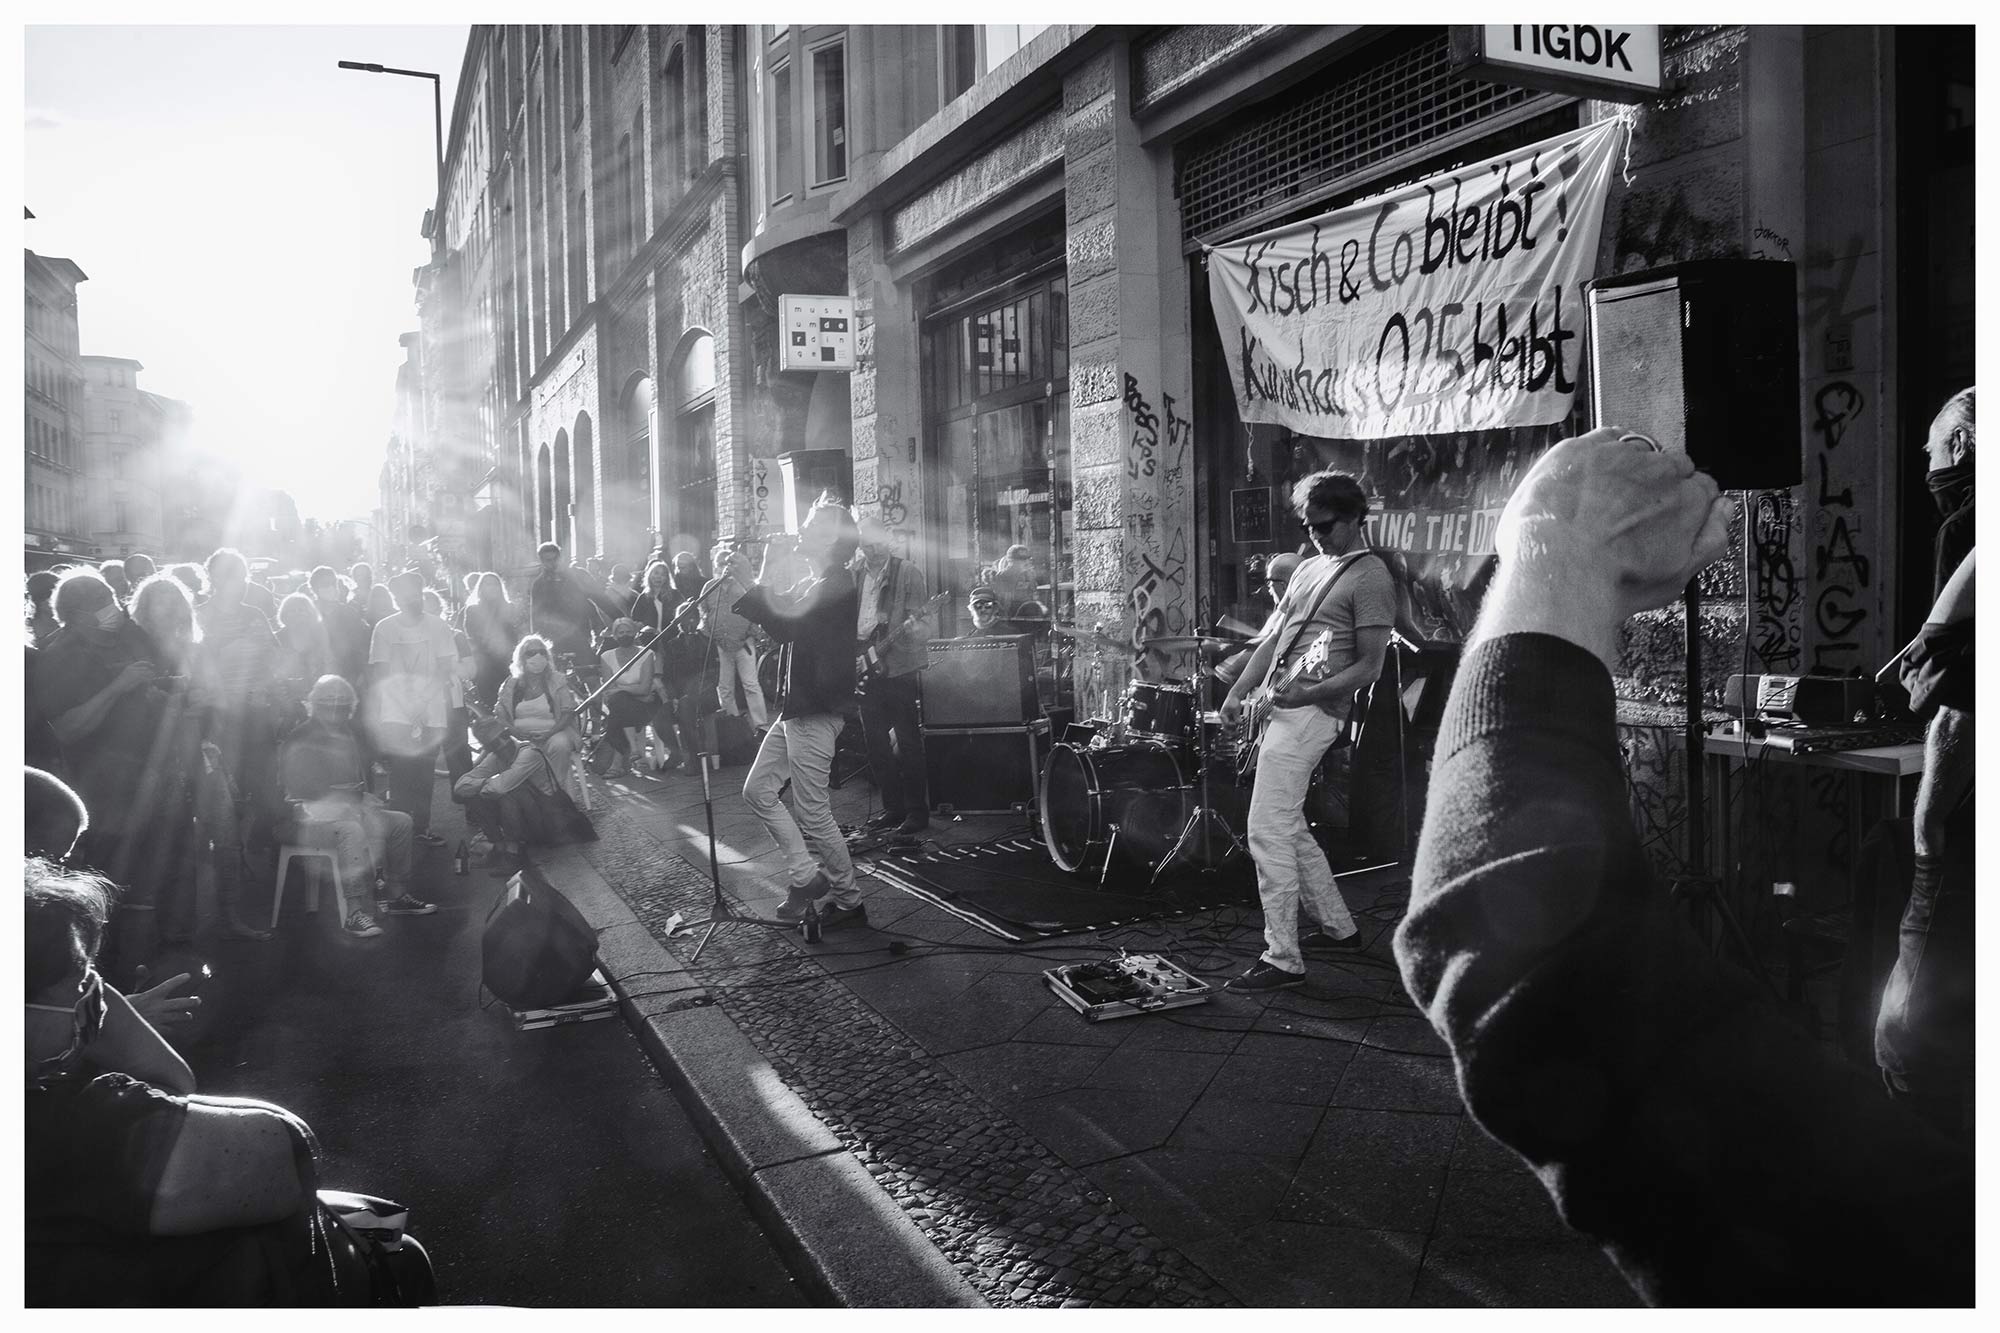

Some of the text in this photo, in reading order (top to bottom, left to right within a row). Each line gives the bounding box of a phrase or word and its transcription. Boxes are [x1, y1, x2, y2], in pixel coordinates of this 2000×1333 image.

[1244, 223, 1331, 317] Kisch
[1339, 239, 1361, 305] &
[1368, 202, 1413, 292] Co
[756, 472, 769, 524] YOGA
[1360, 512, 1417, 550] TING
[1426, 513, 1468, 551] THE
